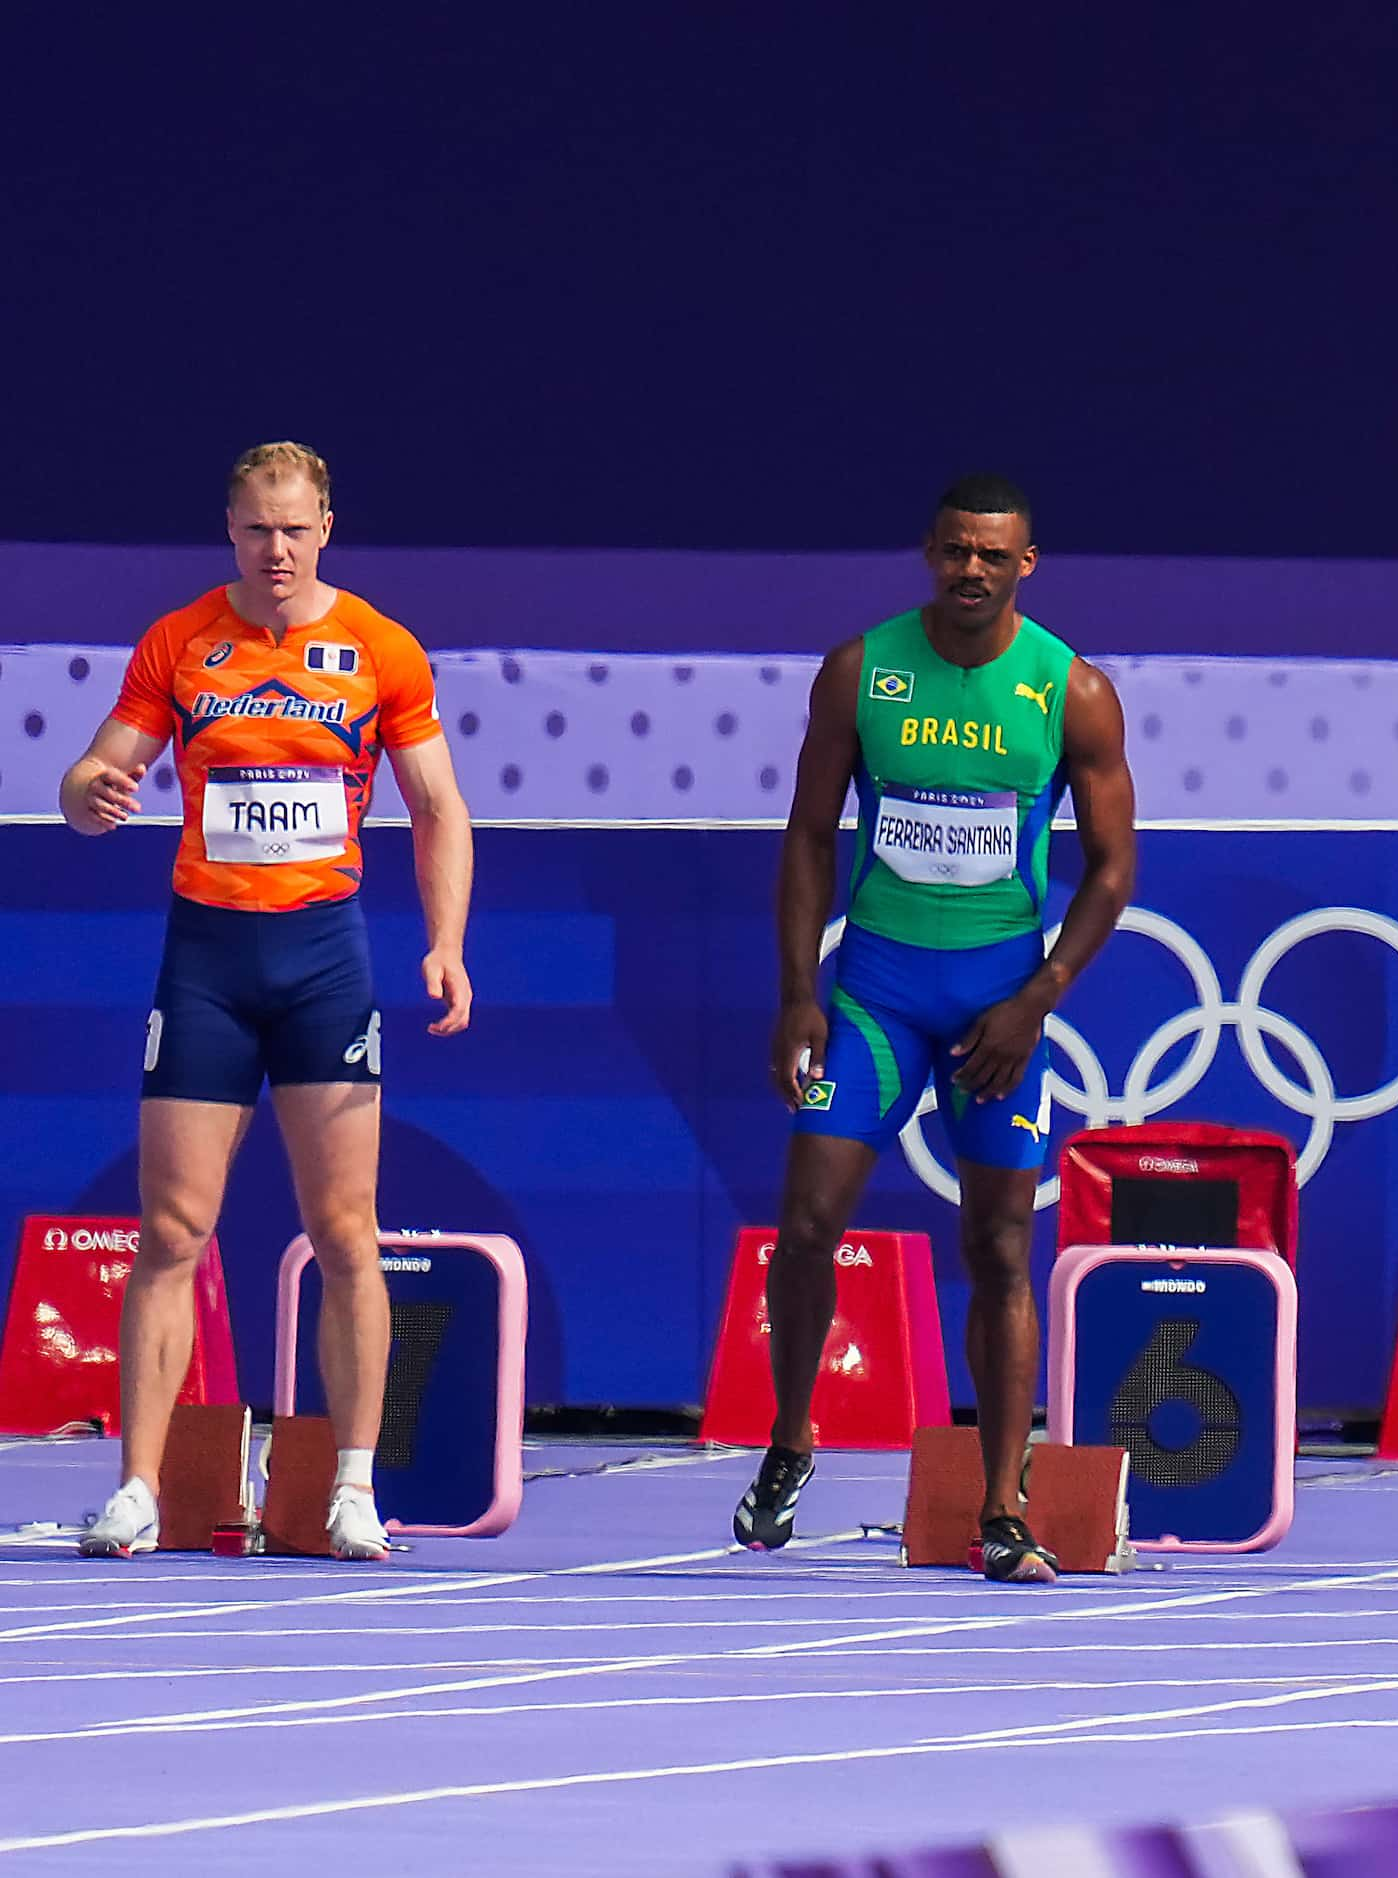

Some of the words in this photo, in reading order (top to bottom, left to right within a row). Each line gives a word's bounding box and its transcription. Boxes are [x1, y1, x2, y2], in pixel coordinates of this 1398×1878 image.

[192, 693, 347, 723] Nederland
[900, 717, 1008, 755] BRASIL
[240, 769, 275, 780] PARIS
[913, 789, 948, 803] PARIS
[229, 801, 320, 833] TAAM
[877, 814, 943, 854] FERREIRA
[945, 824, 1012, 856] SANTANA
[1152, 1279, 1206, 1293] MONDO
[1110, 1318, 1240, 1488] 6
